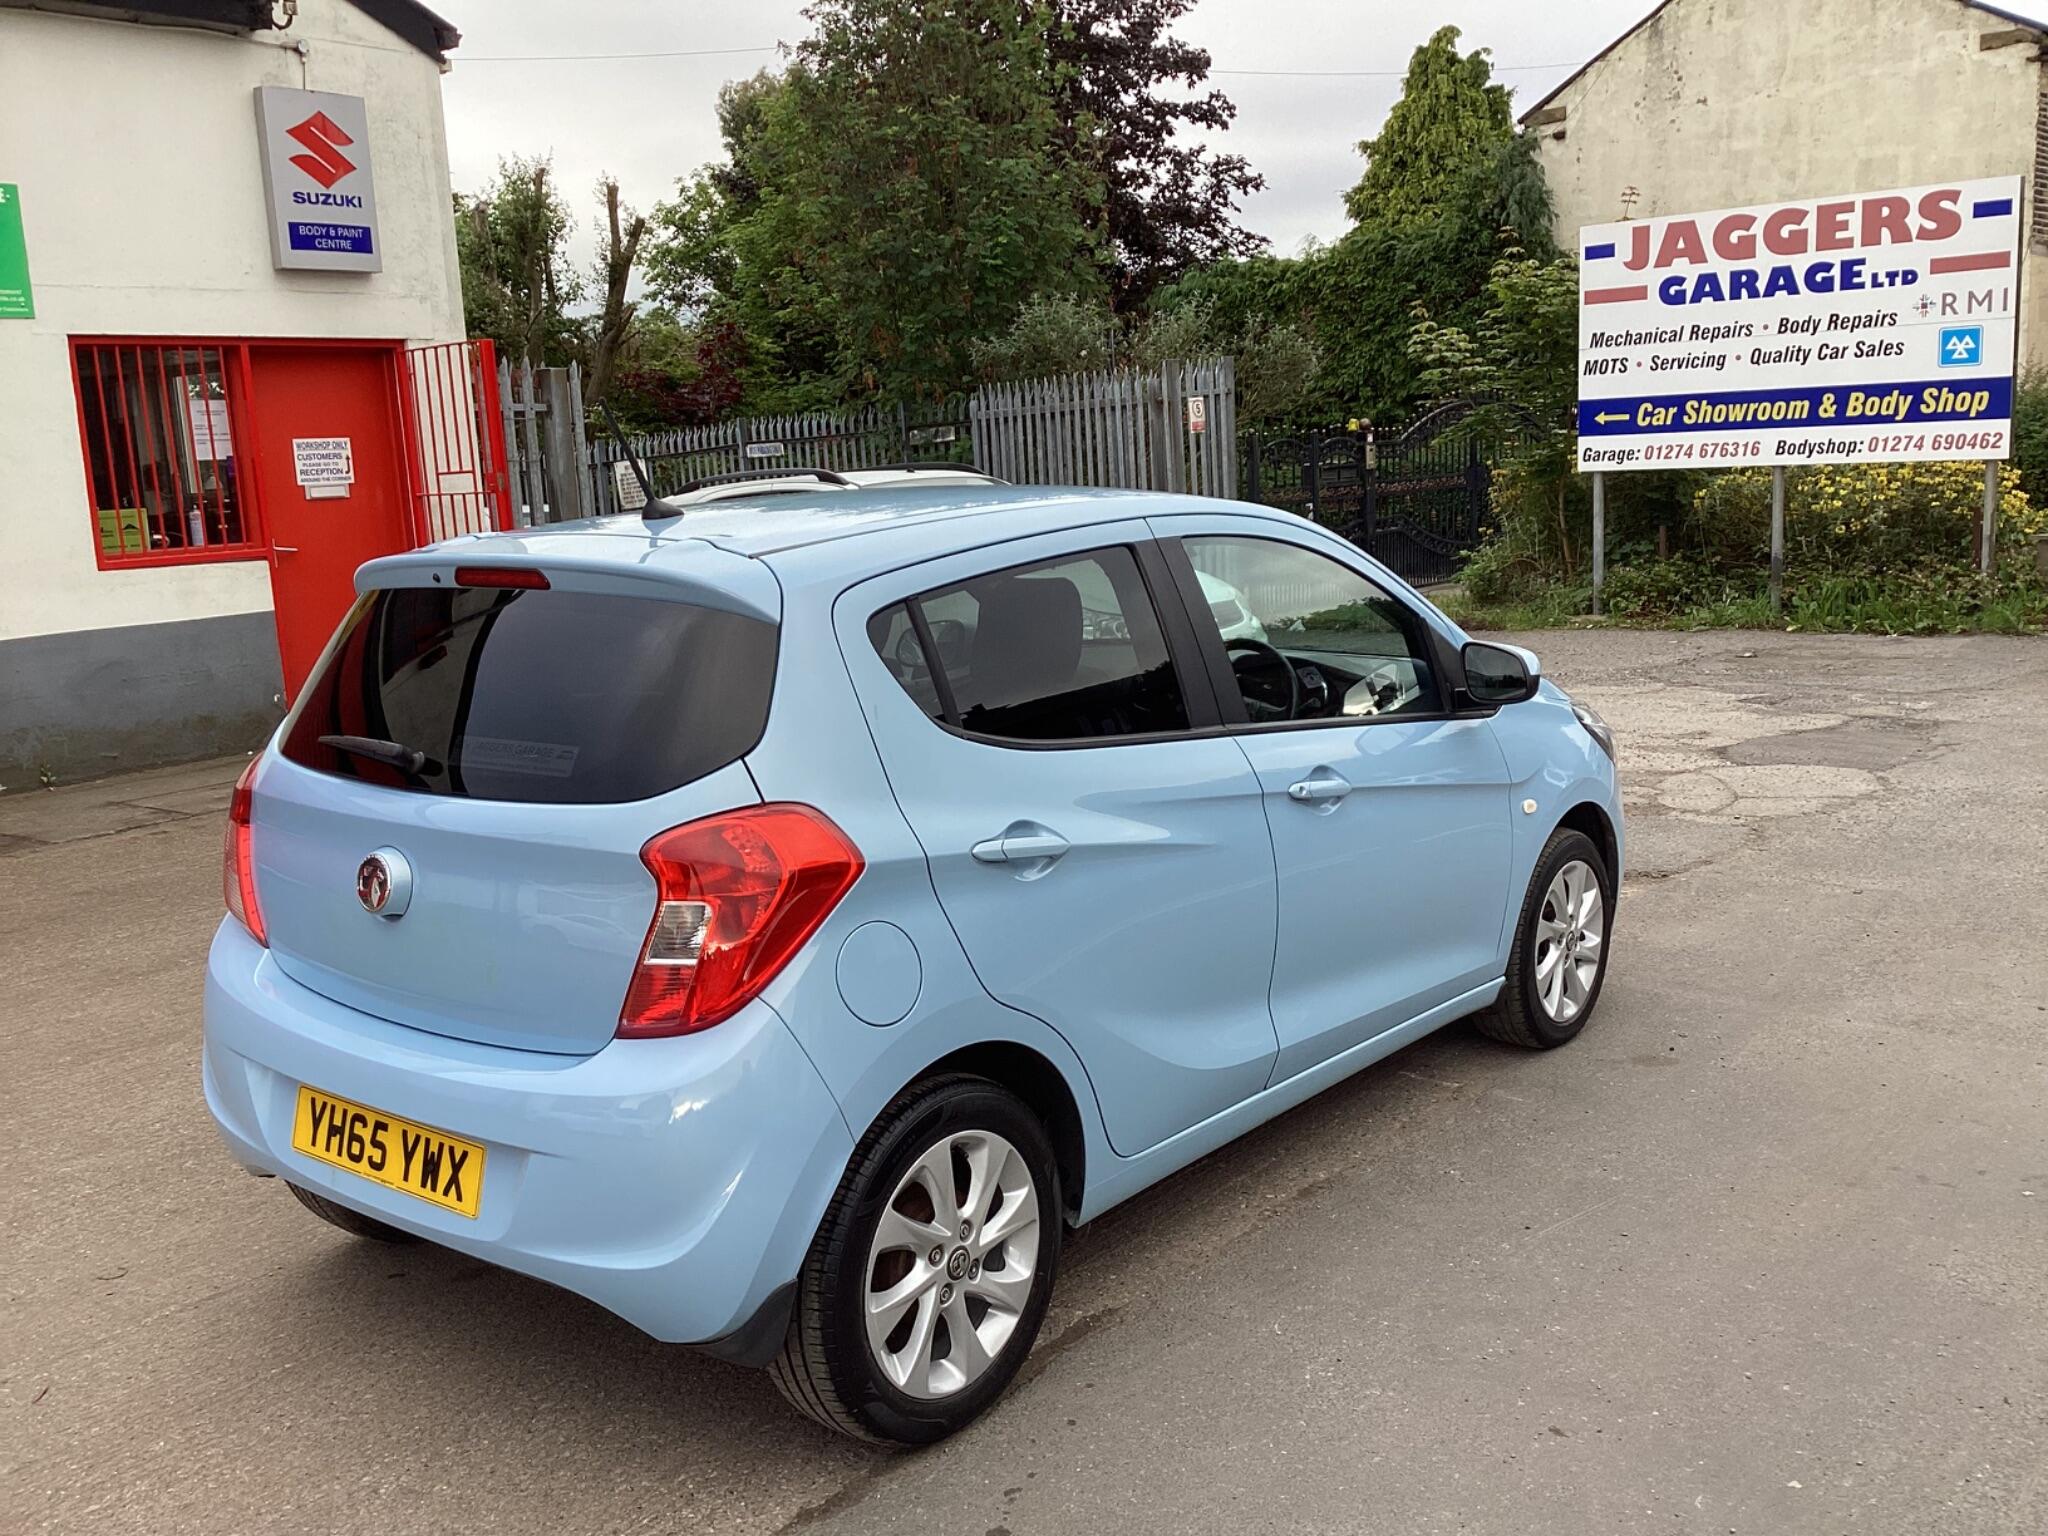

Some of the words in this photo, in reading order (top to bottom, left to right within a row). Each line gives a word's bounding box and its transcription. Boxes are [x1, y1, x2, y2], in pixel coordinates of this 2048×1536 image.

[292, 191, 362, 208] SUZUKI
[298, 225, 327, 236] BODY
[329, 226, 336, 237] &
[337, 227, 363, 238] PAINT
[315, 238, 352, 250] CENTRE
[1623, 189, 1962, 271] JAGGERS
[1658, 257, 1867, 306] GARAGE
[1870, 269, 1919, 289] LTD
[1941, 286, 2009, 316] RMI
[1589, 325, 1685, 349] Mechanical
[1688, 320, 1754, 344] Repairs
[1777, 315, 1822, 336] Body
[1826, 309, 1898, 333] Repairs
[1583, 357, 1629, 376] MOTS
[1649, 351, 1727, 372] Servicing
[1750, 344, 1812, 367] Quality
[1817, 342, 1849, 361] Car
[1854, 339, 1905, 359] Sales
[1636, 402, 1678, 427] Car
[1683, 399, 1810, 425] Showroom
[1818, 392, 1838, 418] &
[1845, 389, 1914, 421] Body
[1920, 387, 1990, 418] Shop
[295, 441, 330, 450] WORKSHOP
[297, 452, 343, 461] CUSTOMERS
[1582, 447, 1641, 464] Garage:
[1644, 443, 1694, 460] 01274
[1699, 440, 1761, 458] 676316
[1775, 437, 1864, 459] Bodyshop:
[1867, 434, 1925, 453] 01274
[1931, 431, 2004, 450] 690462
[300, 468, 343, 476] RECEPTION
[310, 1096, 389, 1172] YH65
[401, 1128, 469, 1203] YWX
